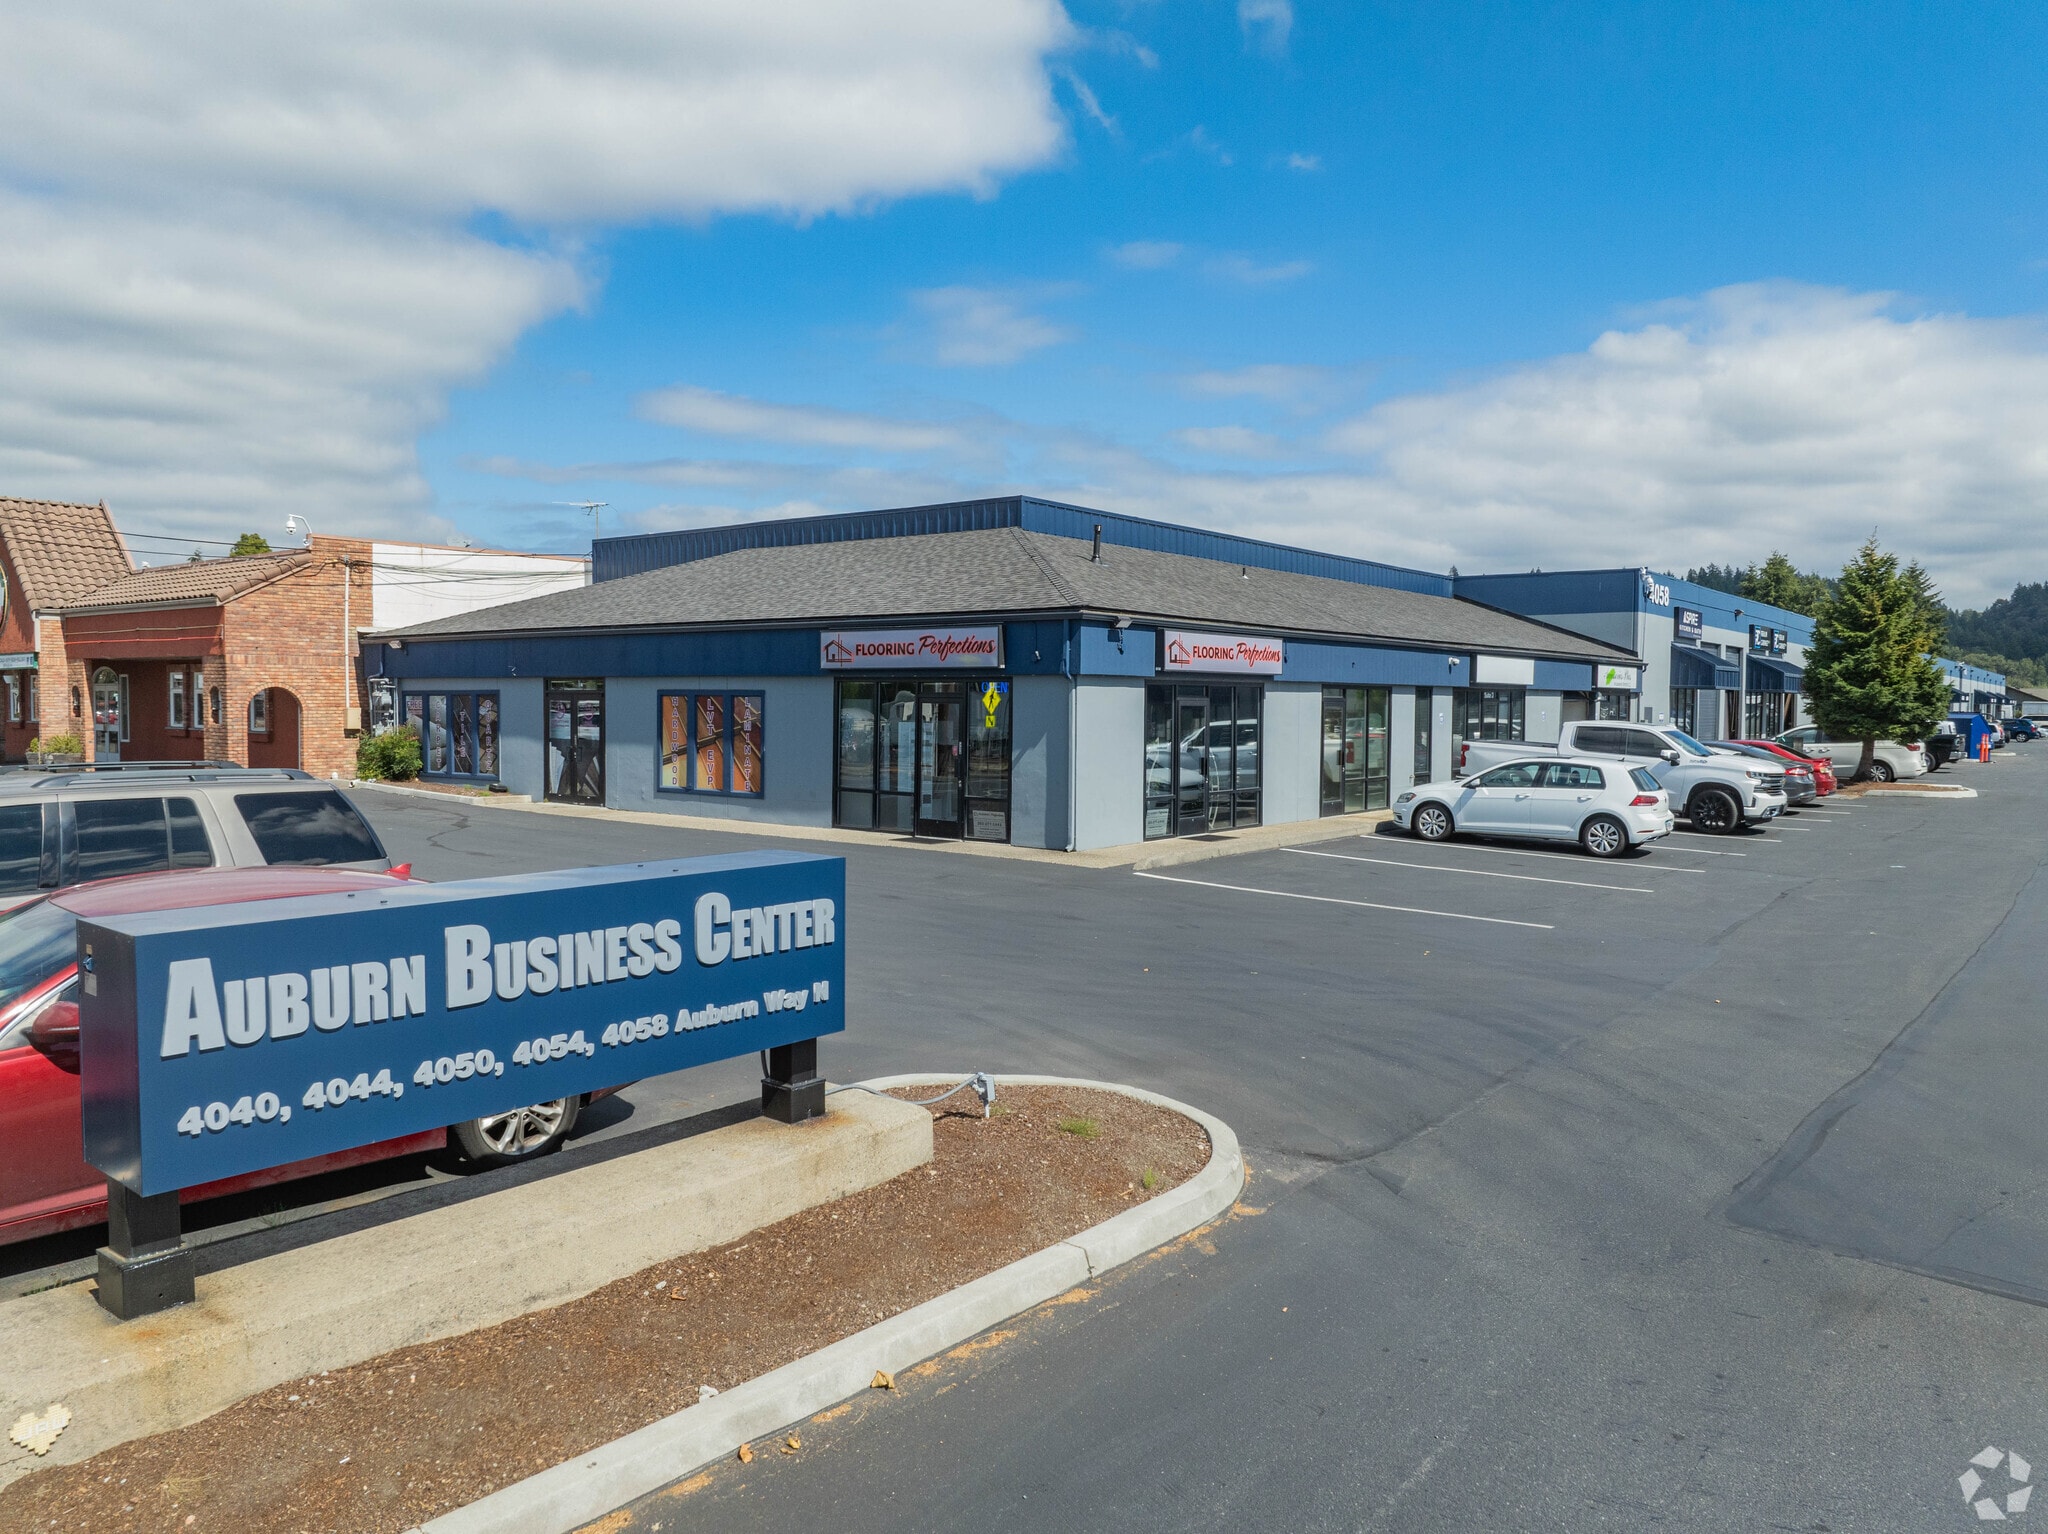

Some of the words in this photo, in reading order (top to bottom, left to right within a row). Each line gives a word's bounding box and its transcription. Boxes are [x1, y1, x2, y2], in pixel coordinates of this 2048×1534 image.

[1649, 583, 1669, 606] 4058
[855, 642, 915, 656] FLOORING
[919, 635, 996, 662] Perfections
[1192, 645, 1234, 660] FLOORING
[1236, 642, 1281, 668] Perfections
[981, 681, 1009, 694] OEN
[706, 698, 715, 736] LVT
[743, 696, 752, 791] LAMINATE
[706, 750, 715, 786] EVP
[160, 957, 426, 1061] AUBURN
[444, 919, 682, 1009] BUSINESS
[694, 891, 836, 967] CENTER
[177, 1091, 292, 1136] 4040,
[302, 1069, 404, 1110] 4044,
[413, 1049, 504, 1087] 4050,
[512, 1030, 595, 1066] 4054,
[601, 1013, 669, 1047] 4058
[674, 999, 759, 1033] Auburn
[763, 988, 809, 1014] Way
[813, 980, 830, 1003] N
